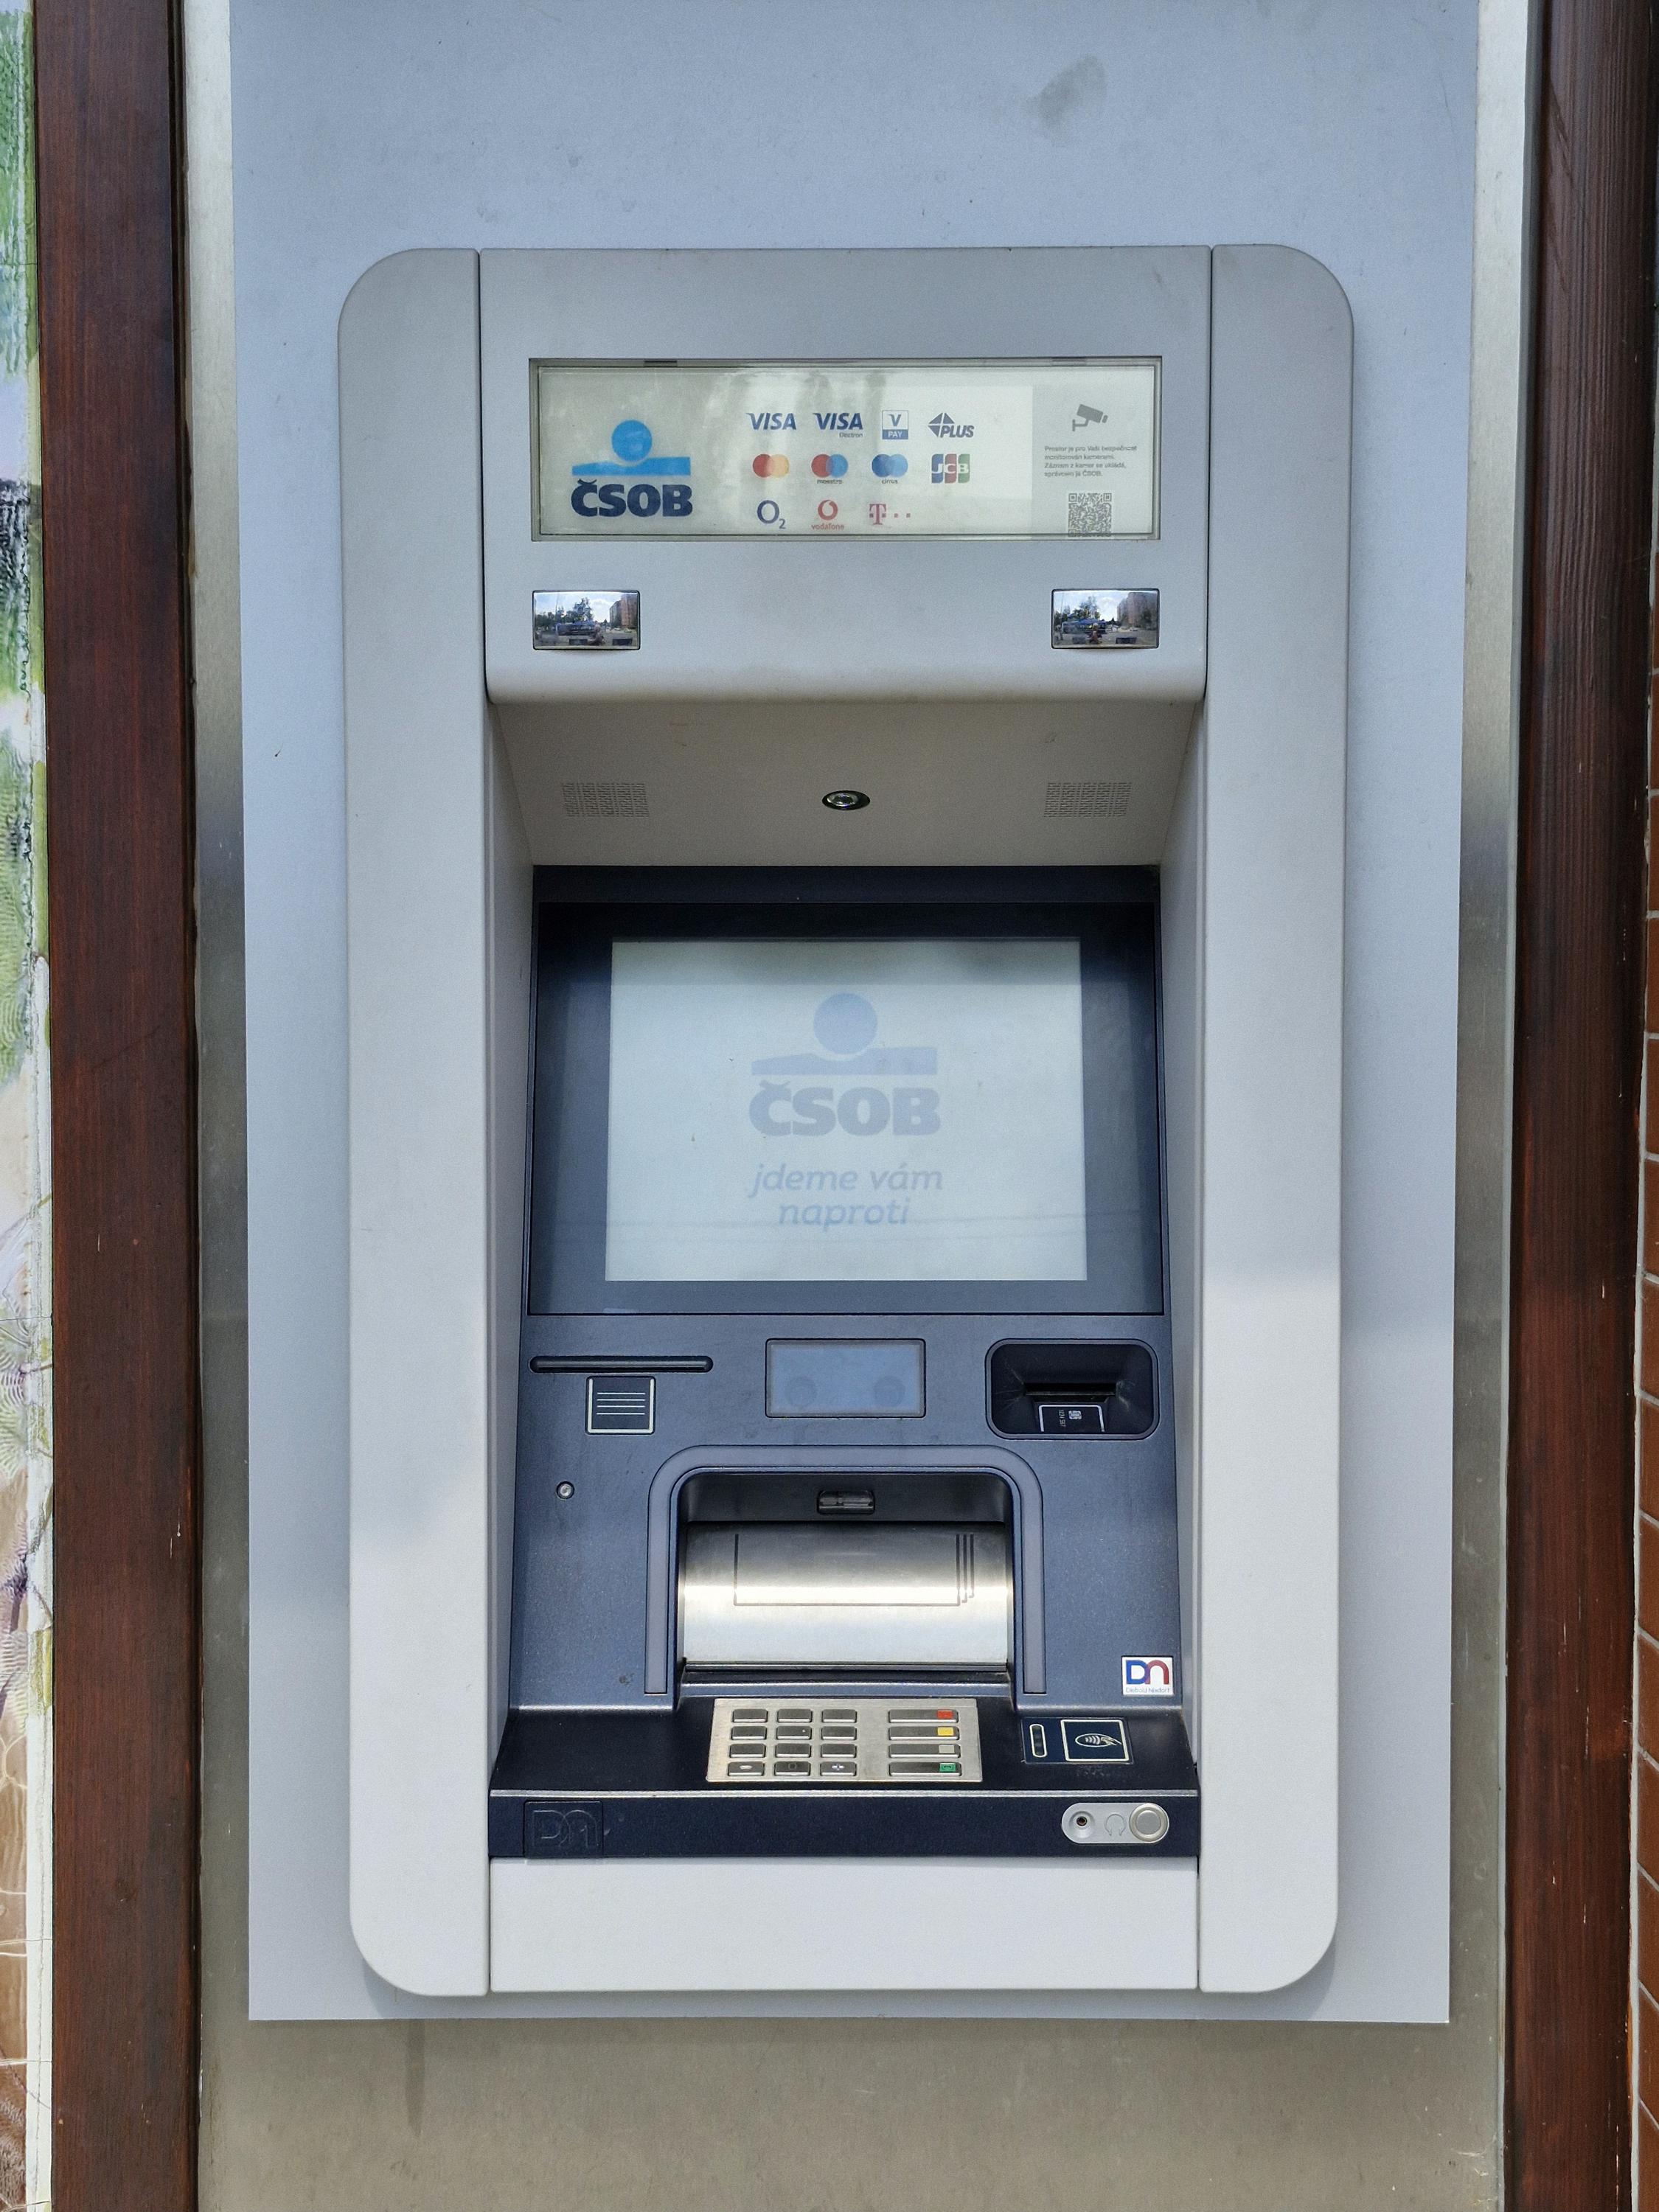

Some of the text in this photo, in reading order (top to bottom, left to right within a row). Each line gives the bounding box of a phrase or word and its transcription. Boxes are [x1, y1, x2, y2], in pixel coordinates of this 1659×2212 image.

[746, 413, 796, 430] VISA
[813, 413, 863, 430] VISA
[888, 414, 901, 426] V
[940, 425, 974, 438] PLUS
[931, 462, 970, 476] JCB
[571, 479, 693, 518] ČSOB
[748, 1079, 941, 1137] ČSOB
[748, 1162, 942, 1199] jdeme vám
[779, 1197, 911, 1232] naproti
